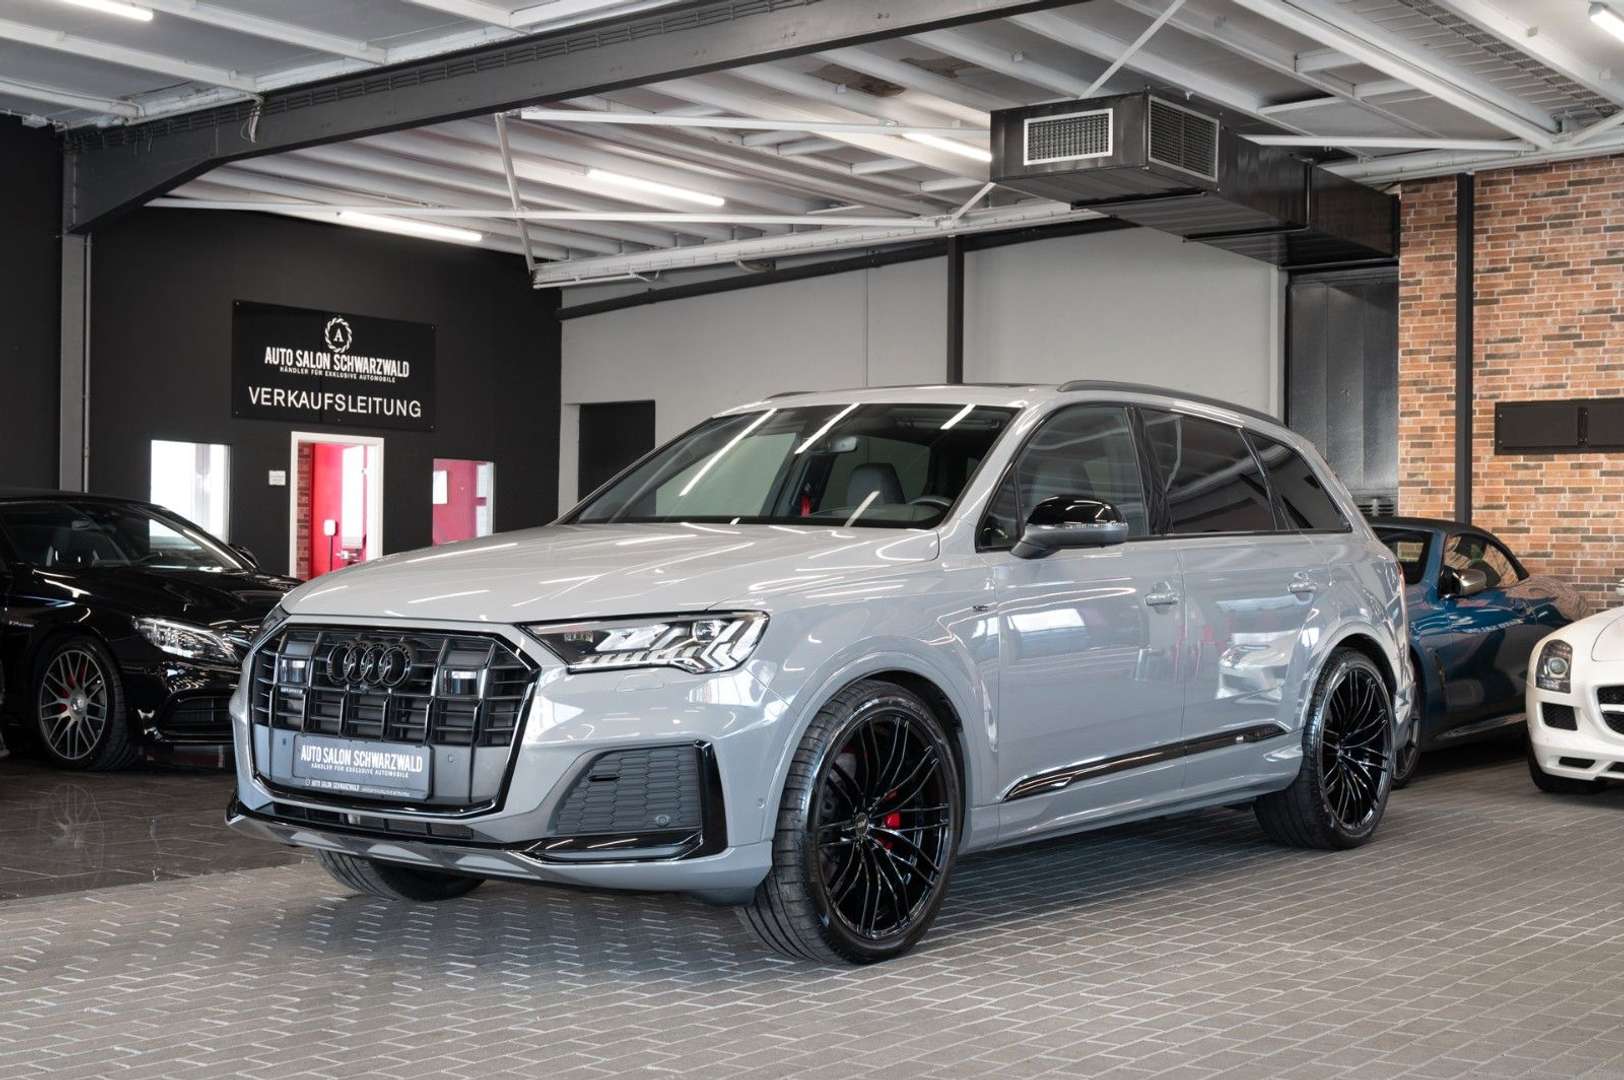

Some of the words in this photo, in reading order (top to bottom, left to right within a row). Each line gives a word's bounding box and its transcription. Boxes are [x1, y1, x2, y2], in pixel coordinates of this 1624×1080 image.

[264, 346, 294, 366] AUTO
[295, 350, 331, 370] SALON
[333, 354, 410, 377] SCHWARZWALD
[279, 366, 309, 375] HÄNDLER
[311, 368, 324, 376] FÜR
[325, 371, 357, 380] EXKLUSIVE
[359, 374, 396, 383] AUTOMOBILE
[248, 386, 422, 418] VERKAUFSLEITUNG
[301, 745, 321, 762] AUTO
[323, 748, 352, 765] SALON
[353, 751, 423, 772] SCHWARZWALD
